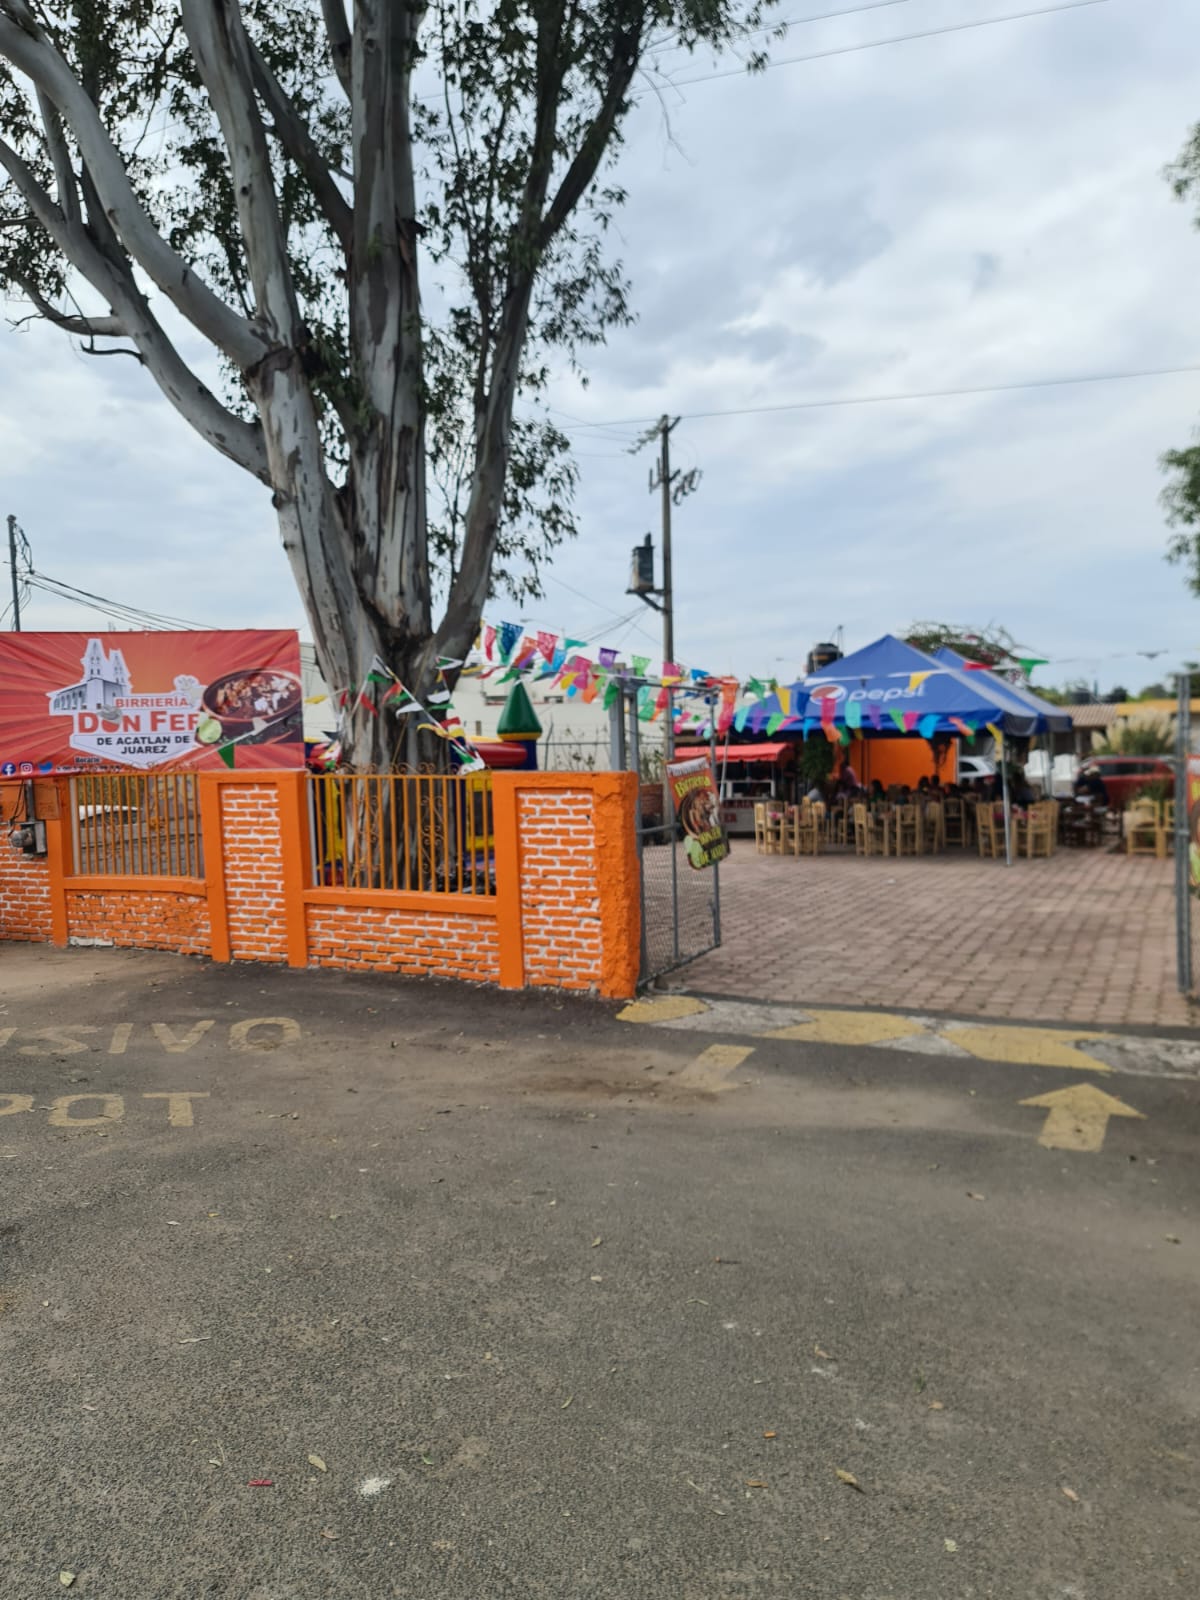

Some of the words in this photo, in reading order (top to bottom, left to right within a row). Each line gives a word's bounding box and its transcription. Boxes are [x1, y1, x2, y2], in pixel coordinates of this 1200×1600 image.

[848, 680, 926, 703] pepsi
[115, 698, 188, 708] BIRRIERÍA
[78, 712, 140, 733] DON
[97, 737, 112, 746] DE
[116, 736, 171, 745] ACATLAN
[175, 736, 190, 744] DE
[121, 745, 167, 754] JUAREZ
[0, 1017, 301, 1056] SIVO
